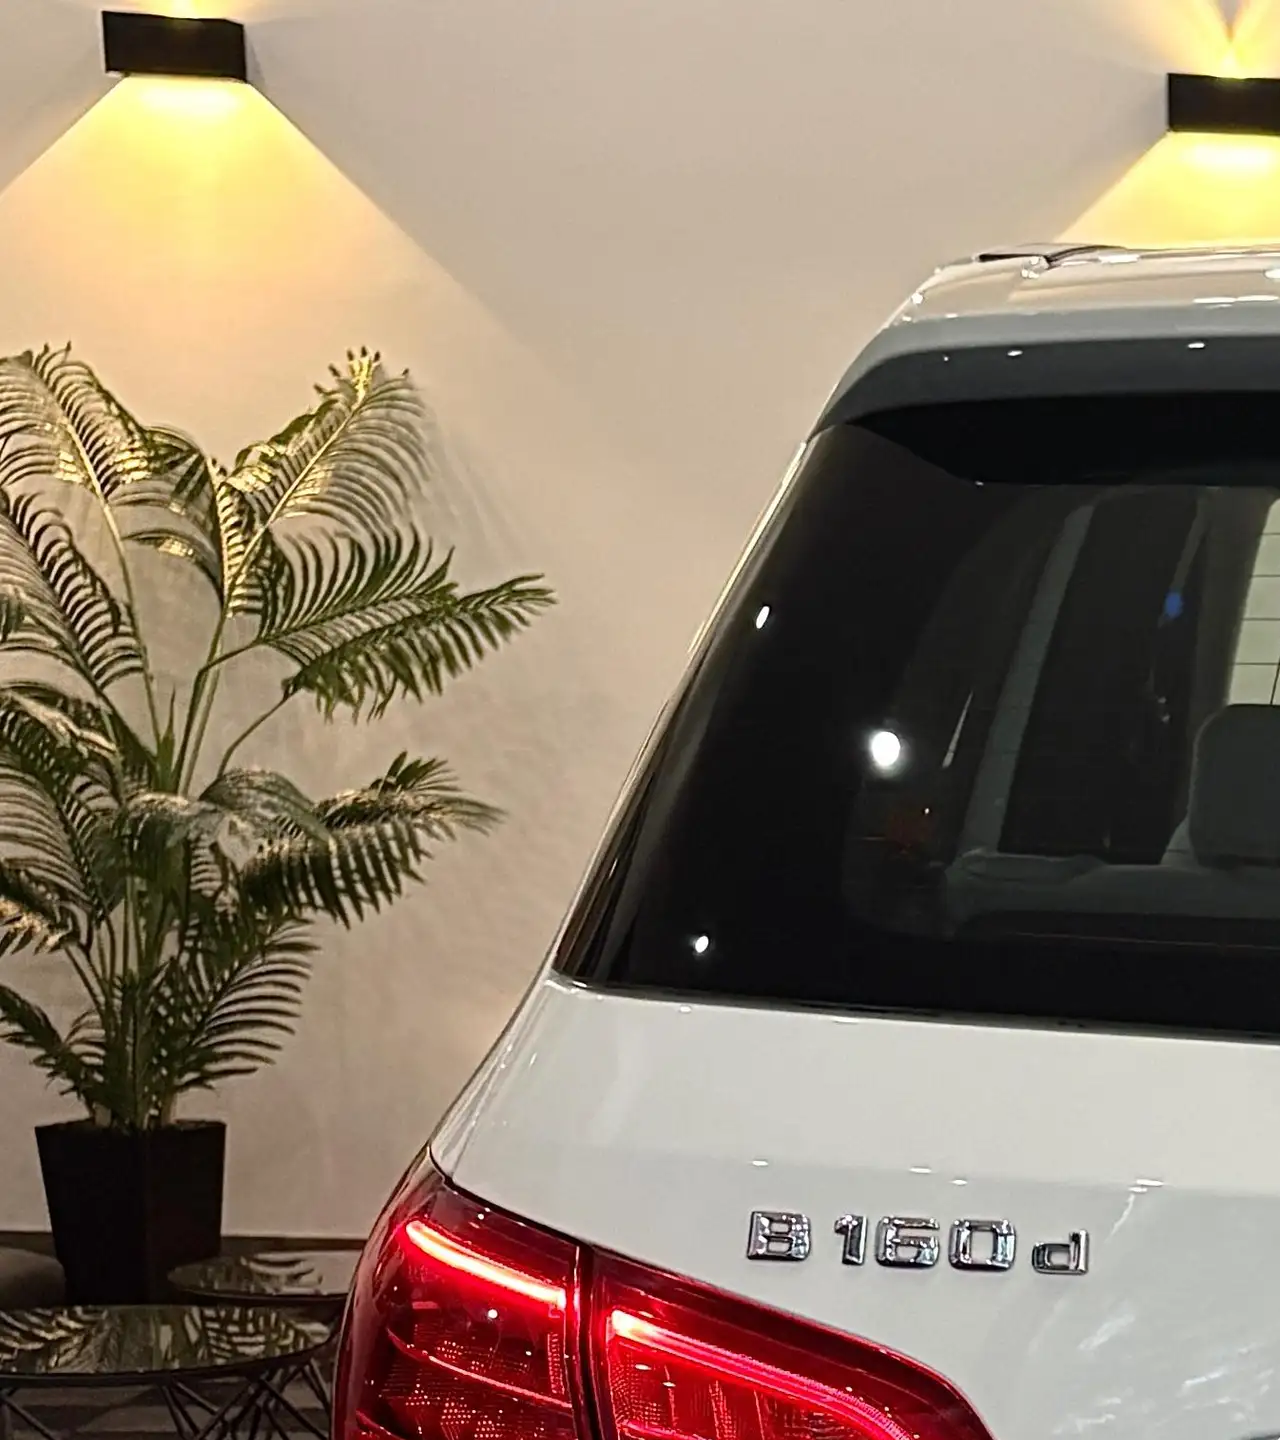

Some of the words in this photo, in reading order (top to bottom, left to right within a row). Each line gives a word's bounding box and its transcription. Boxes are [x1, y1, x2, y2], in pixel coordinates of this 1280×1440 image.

[746, 1210, 812, 1261] B
[834, 1213, 1016, 1271] 160
[1031, 1227, 1090, 1275] d
